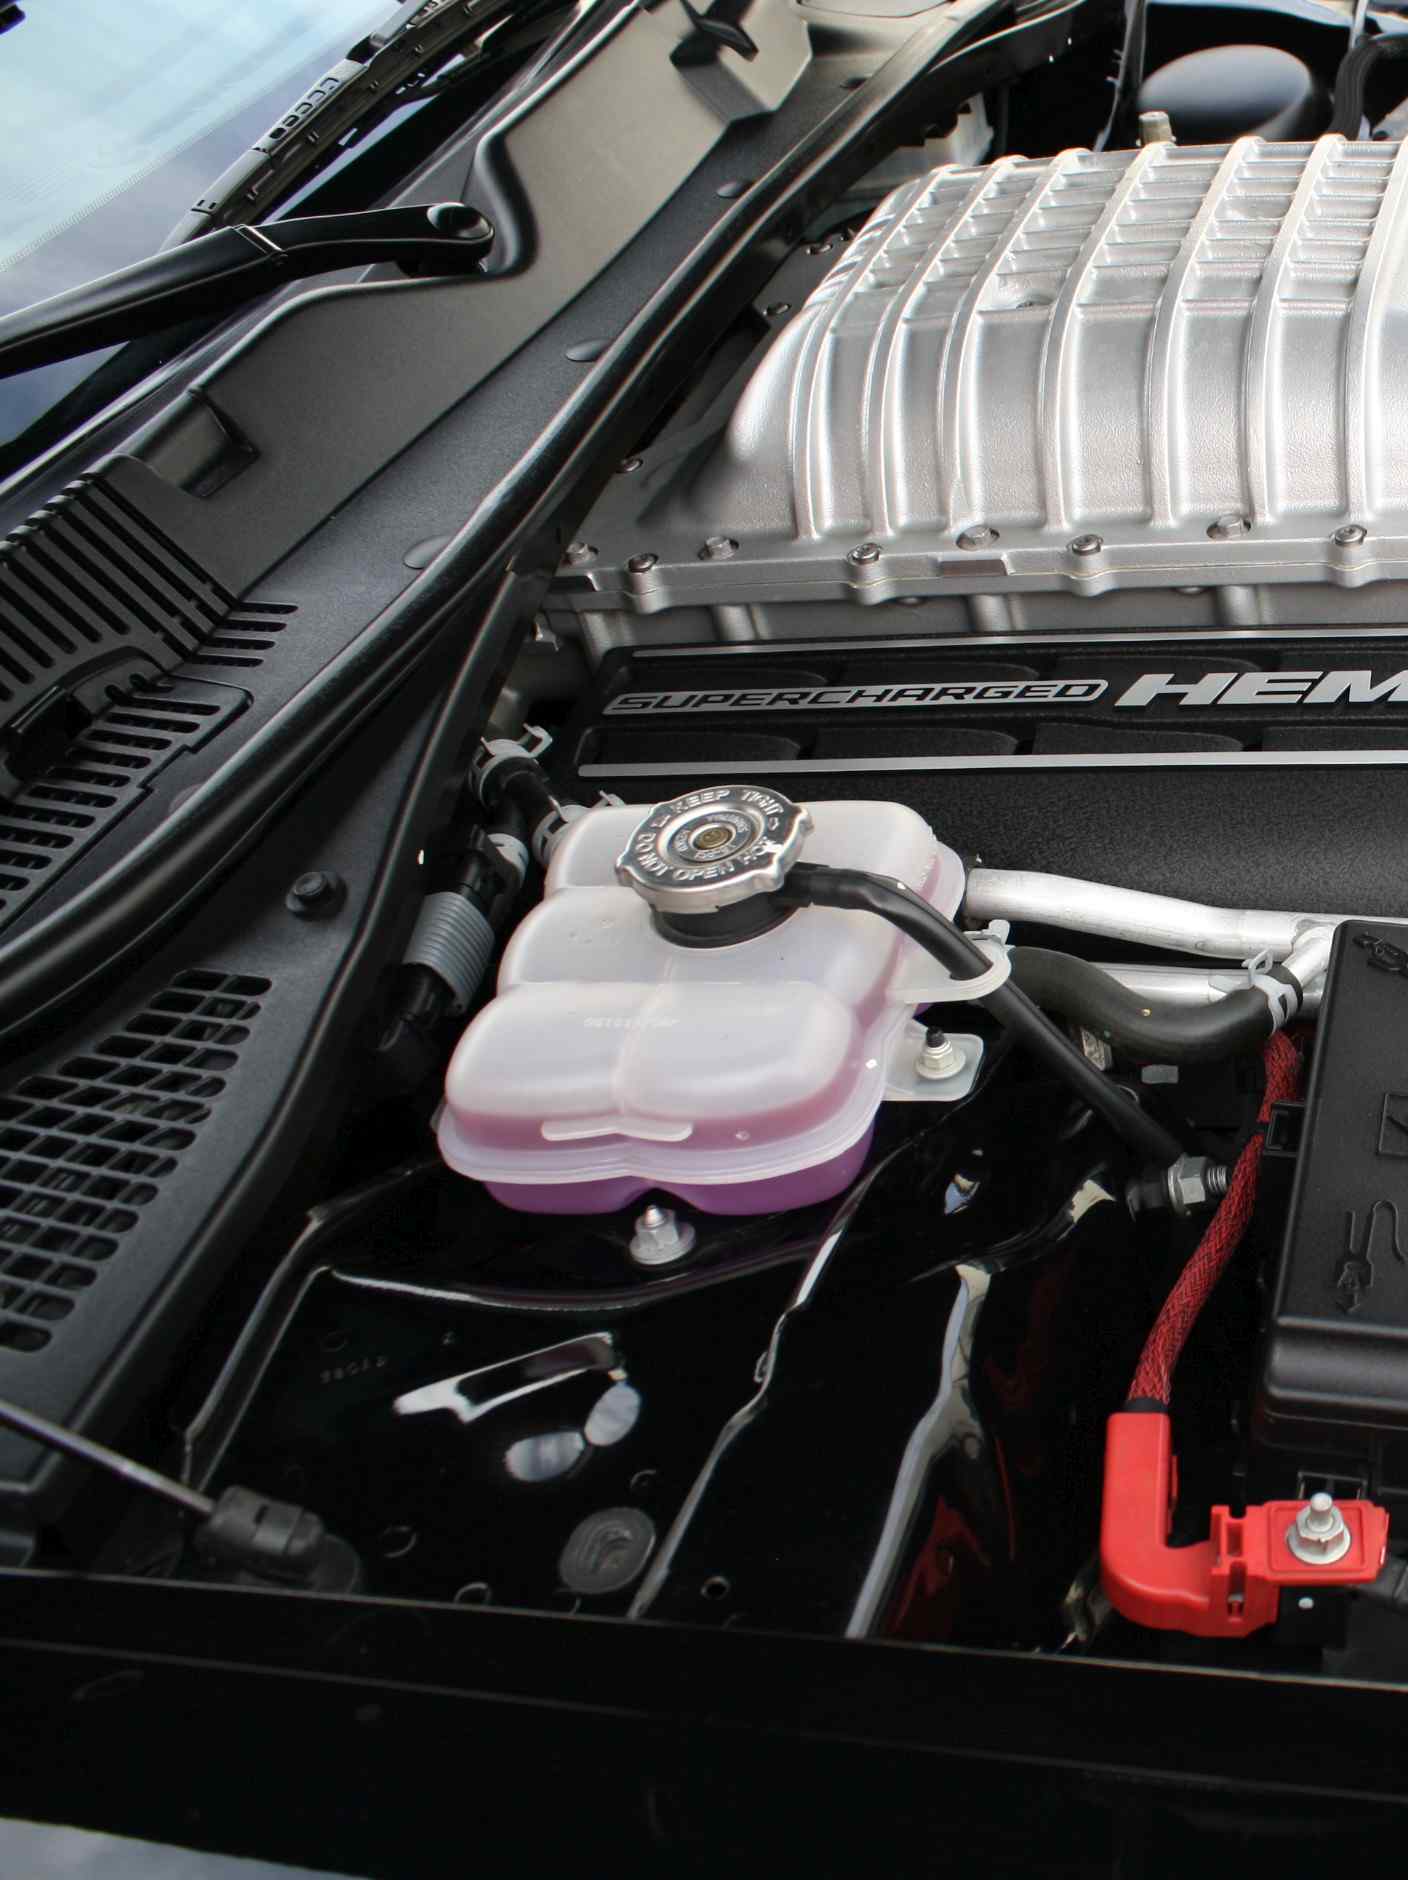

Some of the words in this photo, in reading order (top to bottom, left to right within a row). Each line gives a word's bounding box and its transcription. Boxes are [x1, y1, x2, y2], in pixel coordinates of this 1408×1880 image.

[611, 681, 1100, 712] SUPERCHARGED
[673, 789, 731, 814] KEEP
[741, 789, 785, 816] TIGHT
[635, 833, 657, 853] DO
[636, 853, 671, 877] NOT
[673, 864, 735, 881] OPEN
